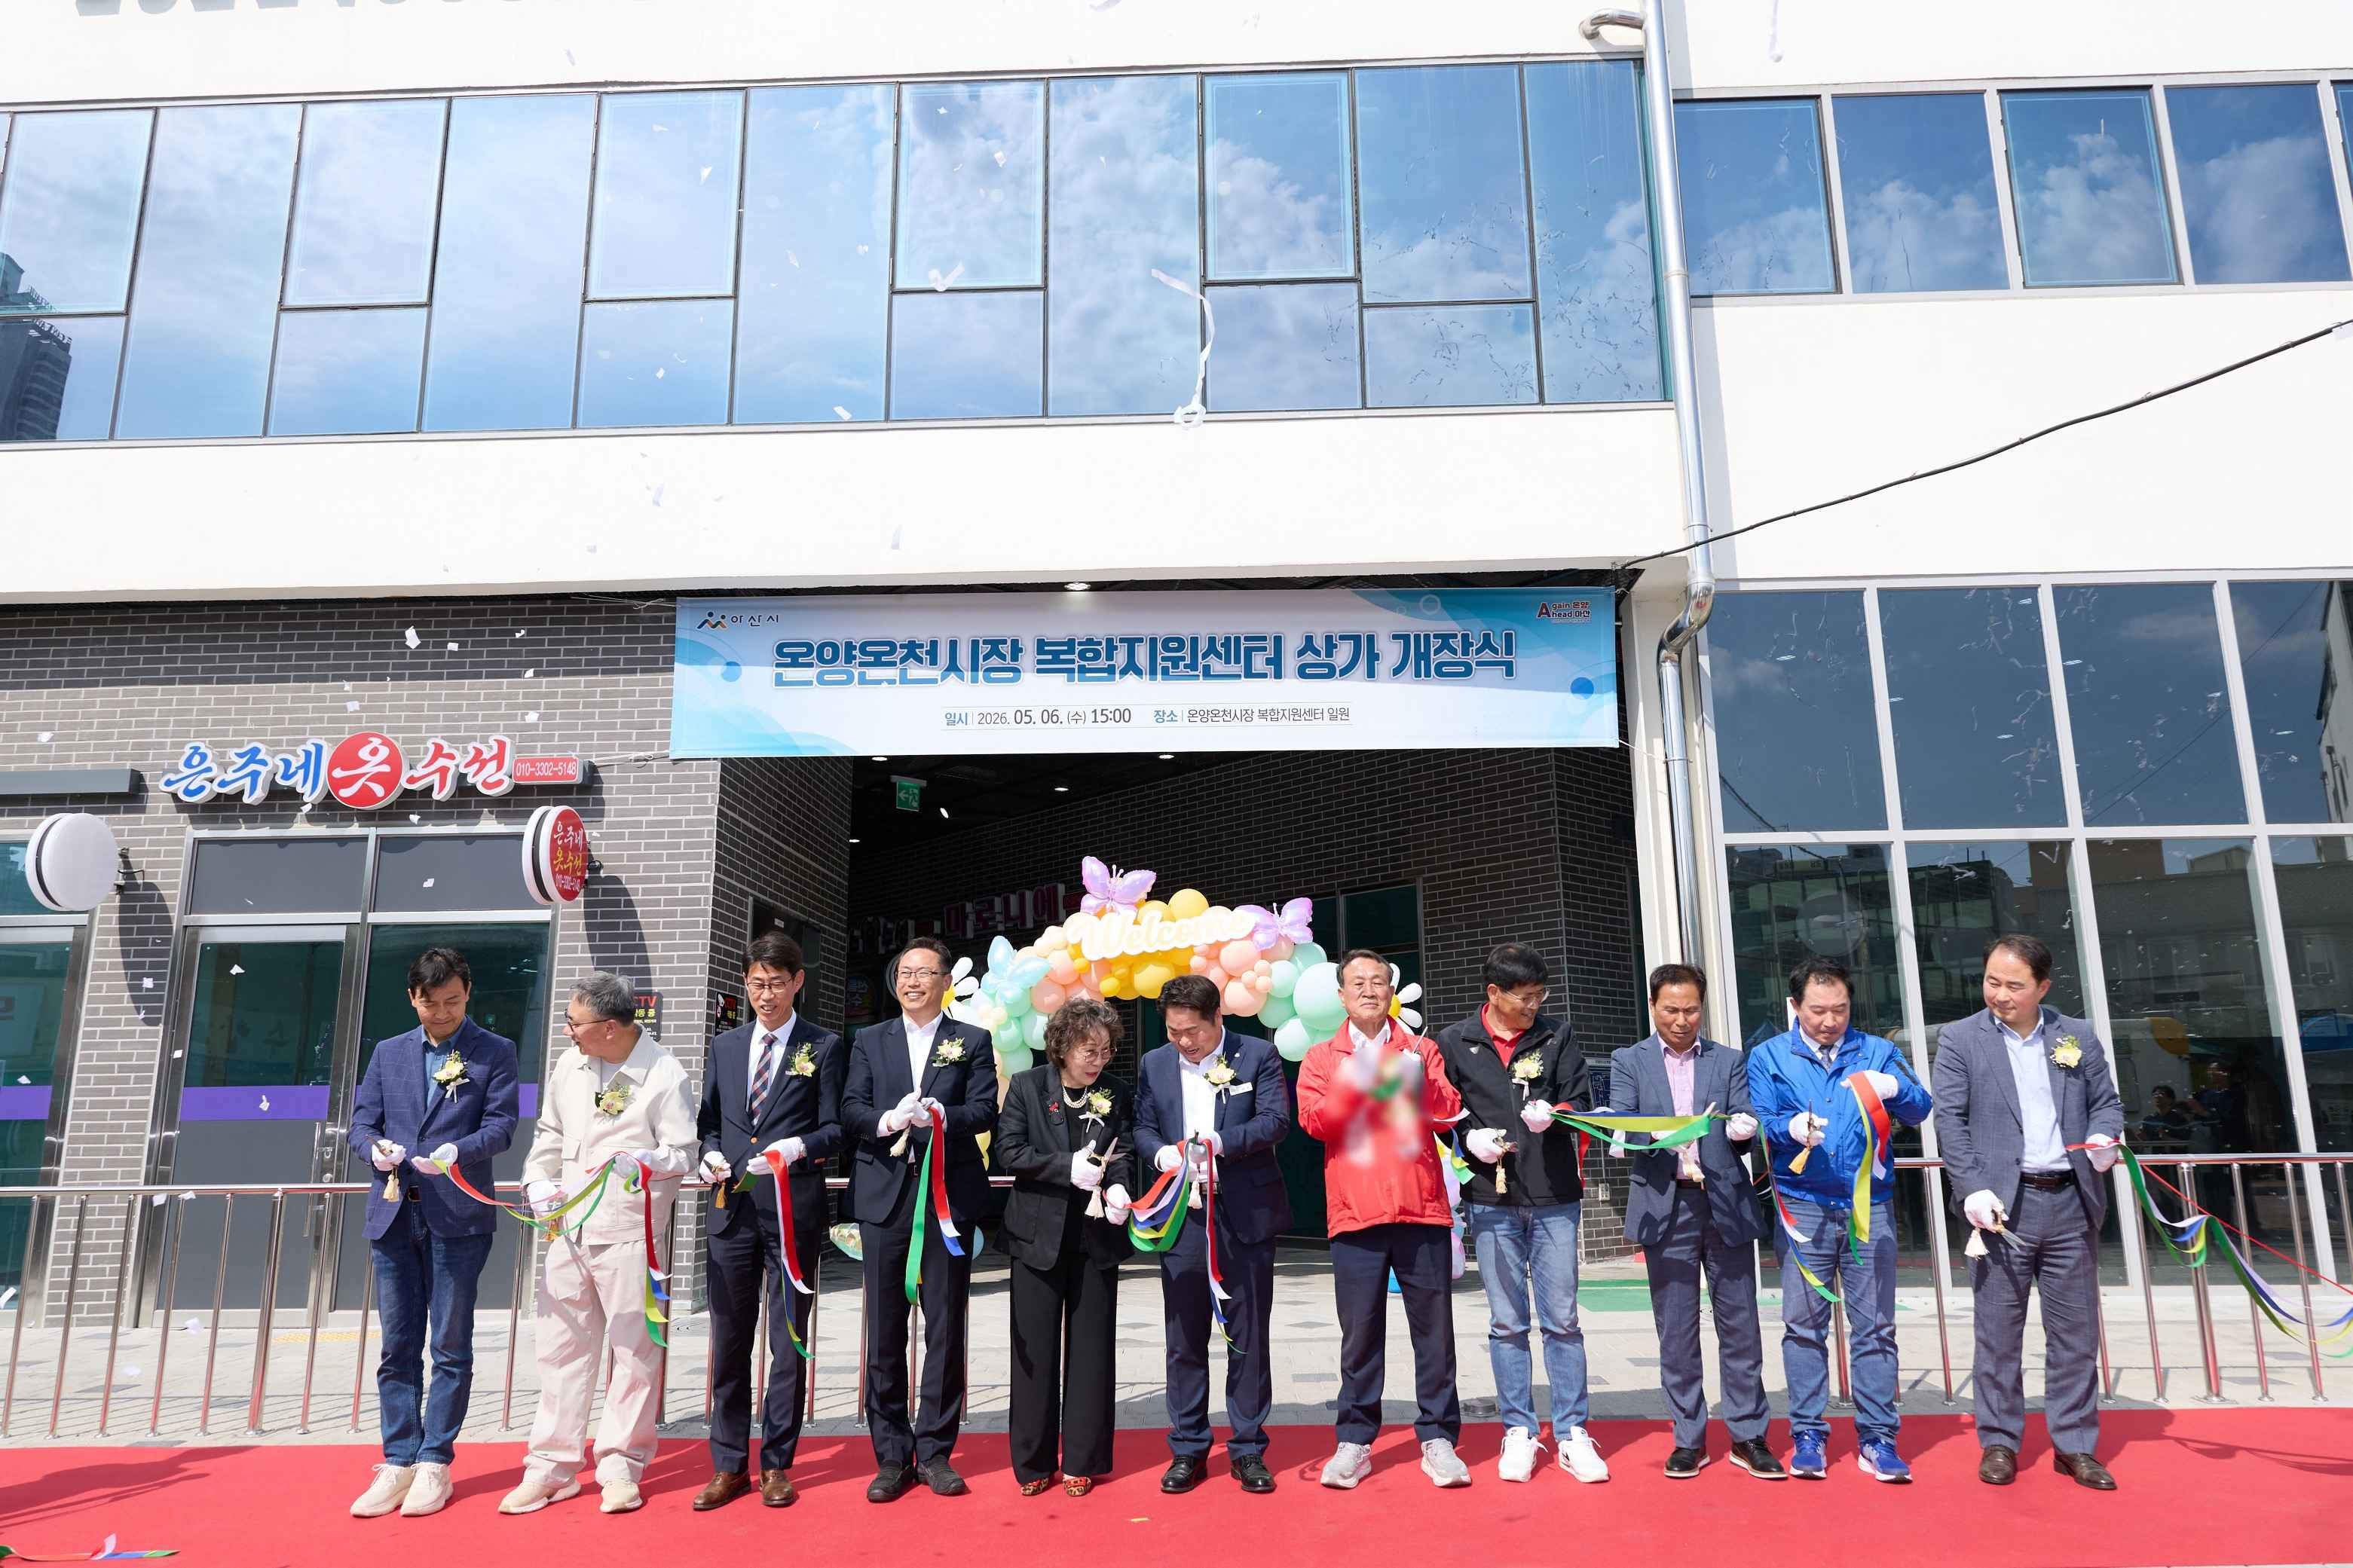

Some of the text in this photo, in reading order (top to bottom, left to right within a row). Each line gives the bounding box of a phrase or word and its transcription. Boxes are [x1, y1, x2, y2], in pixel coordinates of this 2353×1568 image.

[730, 614, 779, 627] 아산시
[773, 630, 1516, 688] 온양온천시장 복합지원센터 상가 개장식
[944, 708, 1131, 726] 일시 2026. 05. 06. (수) 15:00
[1153, 707, 1350, 723] 장소 온양온천시장 복합지원센터 일원
[160, 739, 327, 802] 은주네
[516, 761, 577, 777] 010-3302-5148
[553, 821, 584, 851] 은주네
[553, 846, 583, 876] 옷수선
[1068, 910, 1253, 958] Welcome
